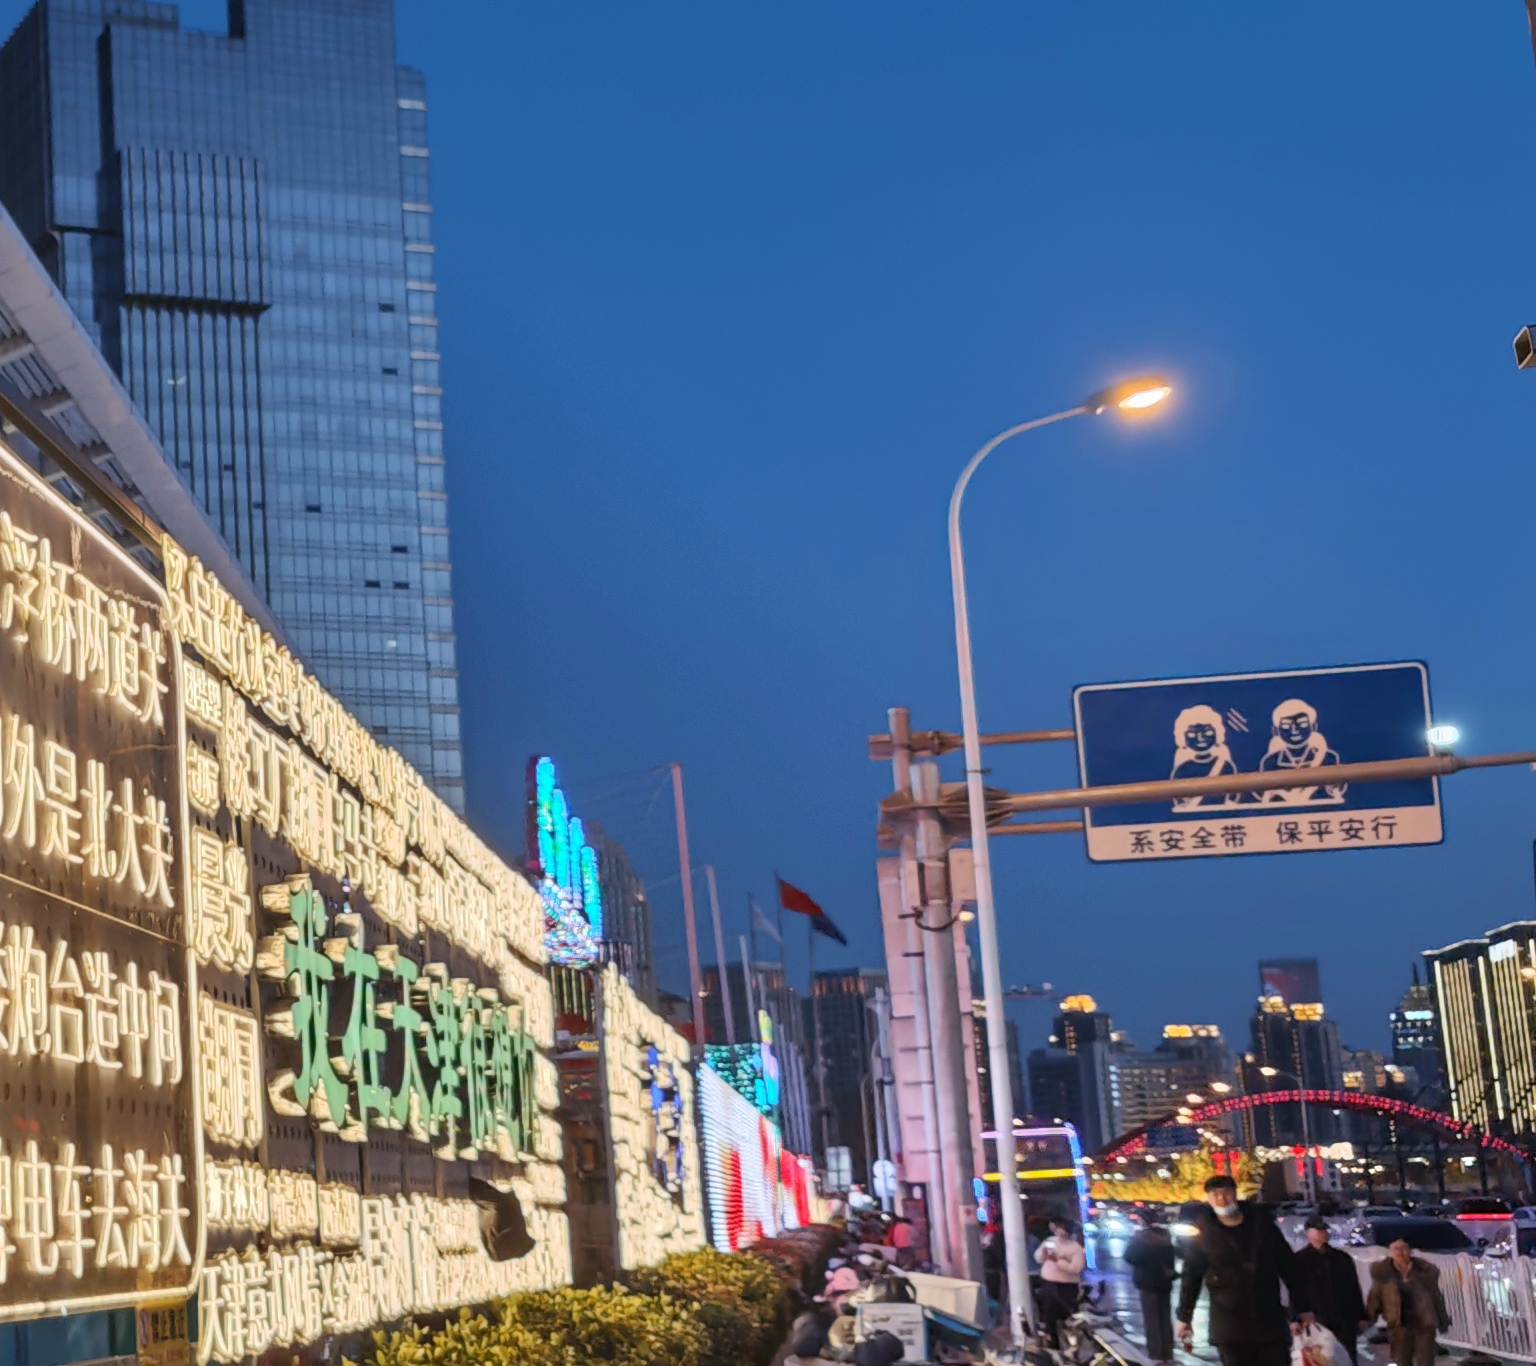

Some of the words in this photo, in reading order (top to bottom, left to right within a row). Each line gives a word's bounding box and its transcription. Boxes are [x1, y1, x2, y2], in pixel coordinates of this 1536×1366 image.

[1129, 824, 1247, 854] 系安全带
[1276, 815, 1398, 844] 保平安行
